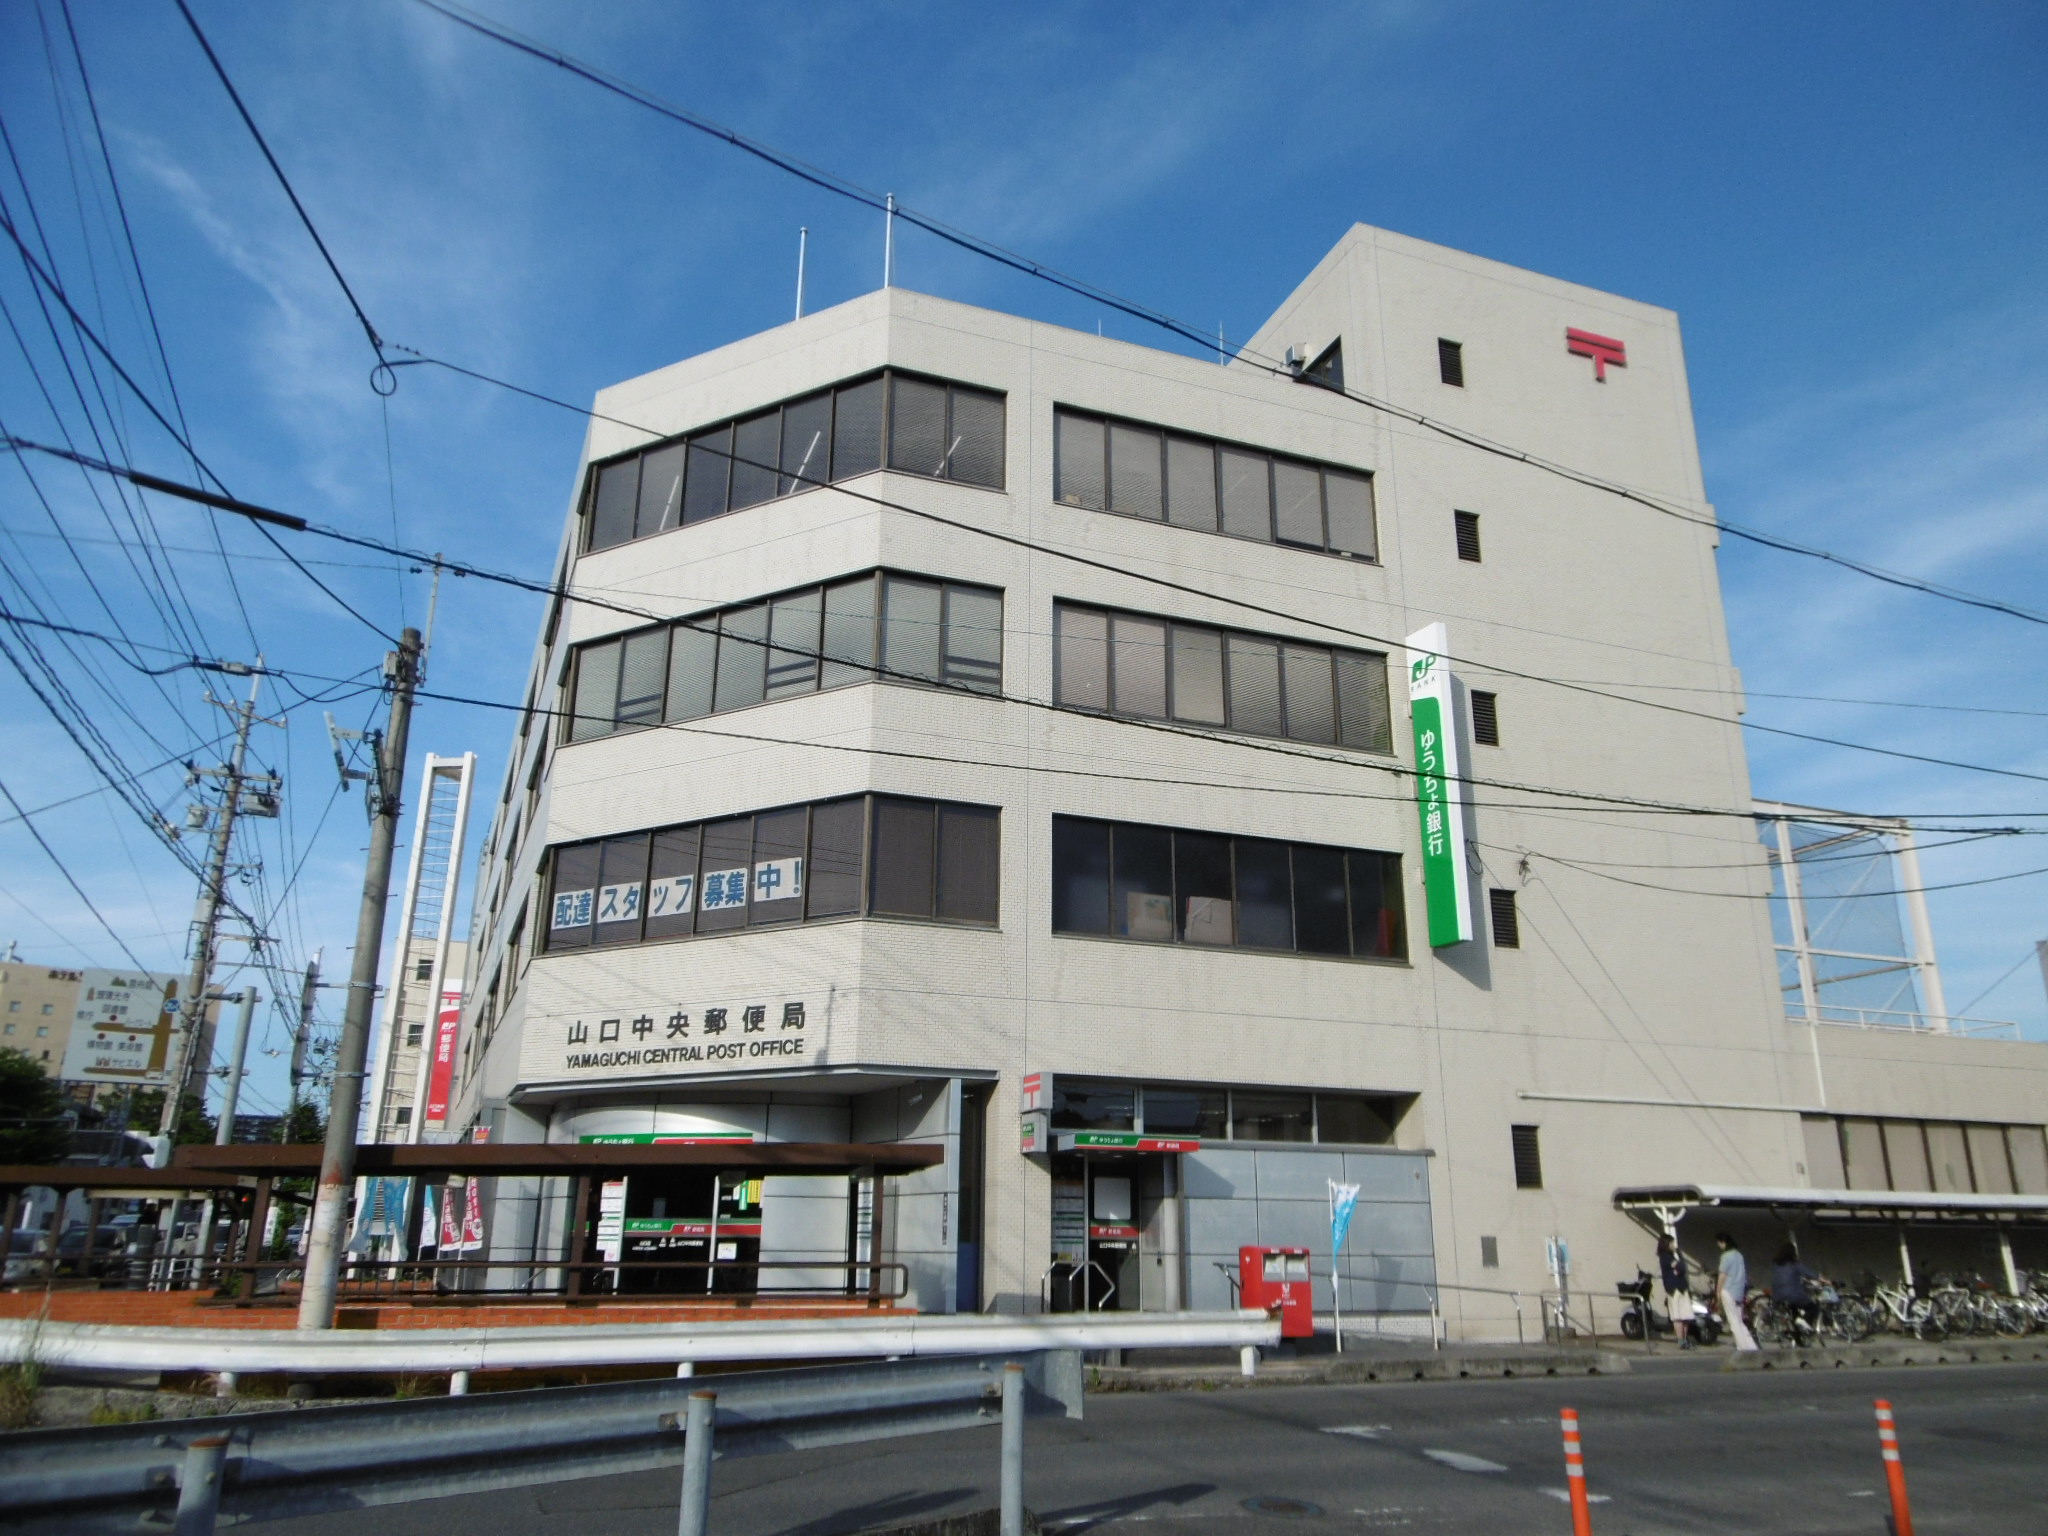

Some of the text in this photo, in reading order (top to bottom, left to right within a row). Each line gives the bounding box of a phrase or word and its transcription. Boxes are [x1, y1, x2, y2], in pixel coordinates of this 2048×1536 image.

[1421, 730, 1444, 857] ゆうちょ銀行
[567, 1002, 805, 1045] 山口中央郵便局
[566, 1039, 804, 1069] YAMAGUCHI CENTRAL POST OFFICE
